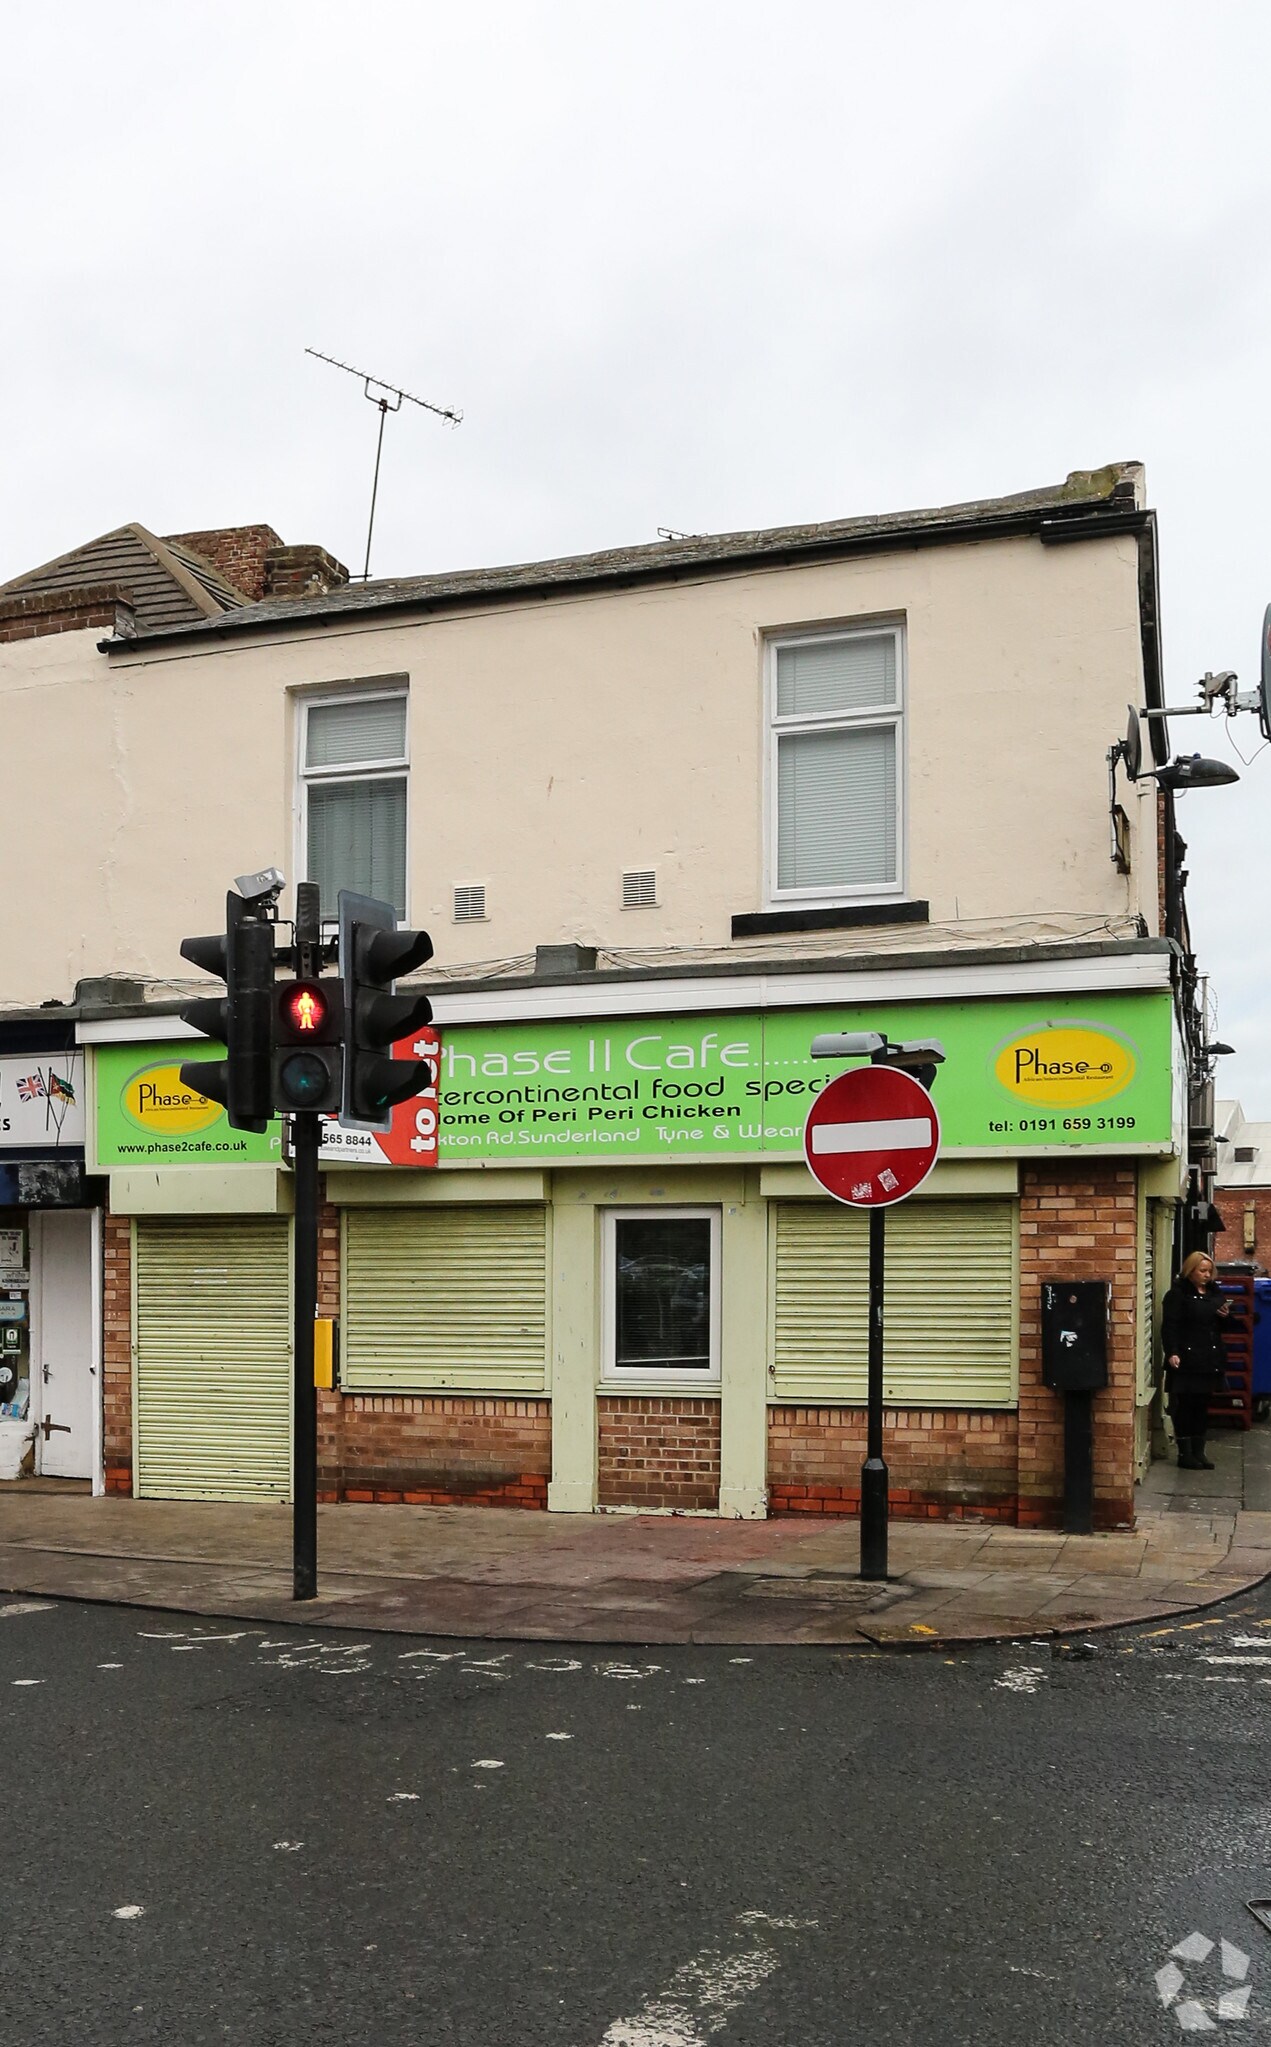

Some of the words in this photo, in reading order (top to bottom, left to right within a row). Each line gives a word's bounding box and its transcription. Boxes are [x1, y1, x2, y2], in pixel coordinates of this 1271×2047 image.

[1015, 1048, 1090, 1084] Phase
[652, 1076, 725, 1099] food
[139, 1083, 192, 1113] Phase
[498, 1109, 525, 1124] Of
[532, 1108, 577, 1122] Peri
[588, 1106, 634, 1120] Peri
[642, 1104, 741, 1119] Chicken
[410, 1107, 437, 1153] to
[655, 1126, 704, 1144] Tyne
[712, 1124, 730, 1139] &
[738, 1124, 803, 1138] Wear
[988, 1120, 1013, 1132] tel:
[1019, 1119, 1056, 1131] 0191
[1062, 1117, 1091, 1130] 659
[1096, 1117, 1136, 1130] 3199
[117, 1140, 248, 1155] www.phase2cafe.co.uk
[345, 1135, 372, 1146] 8844
